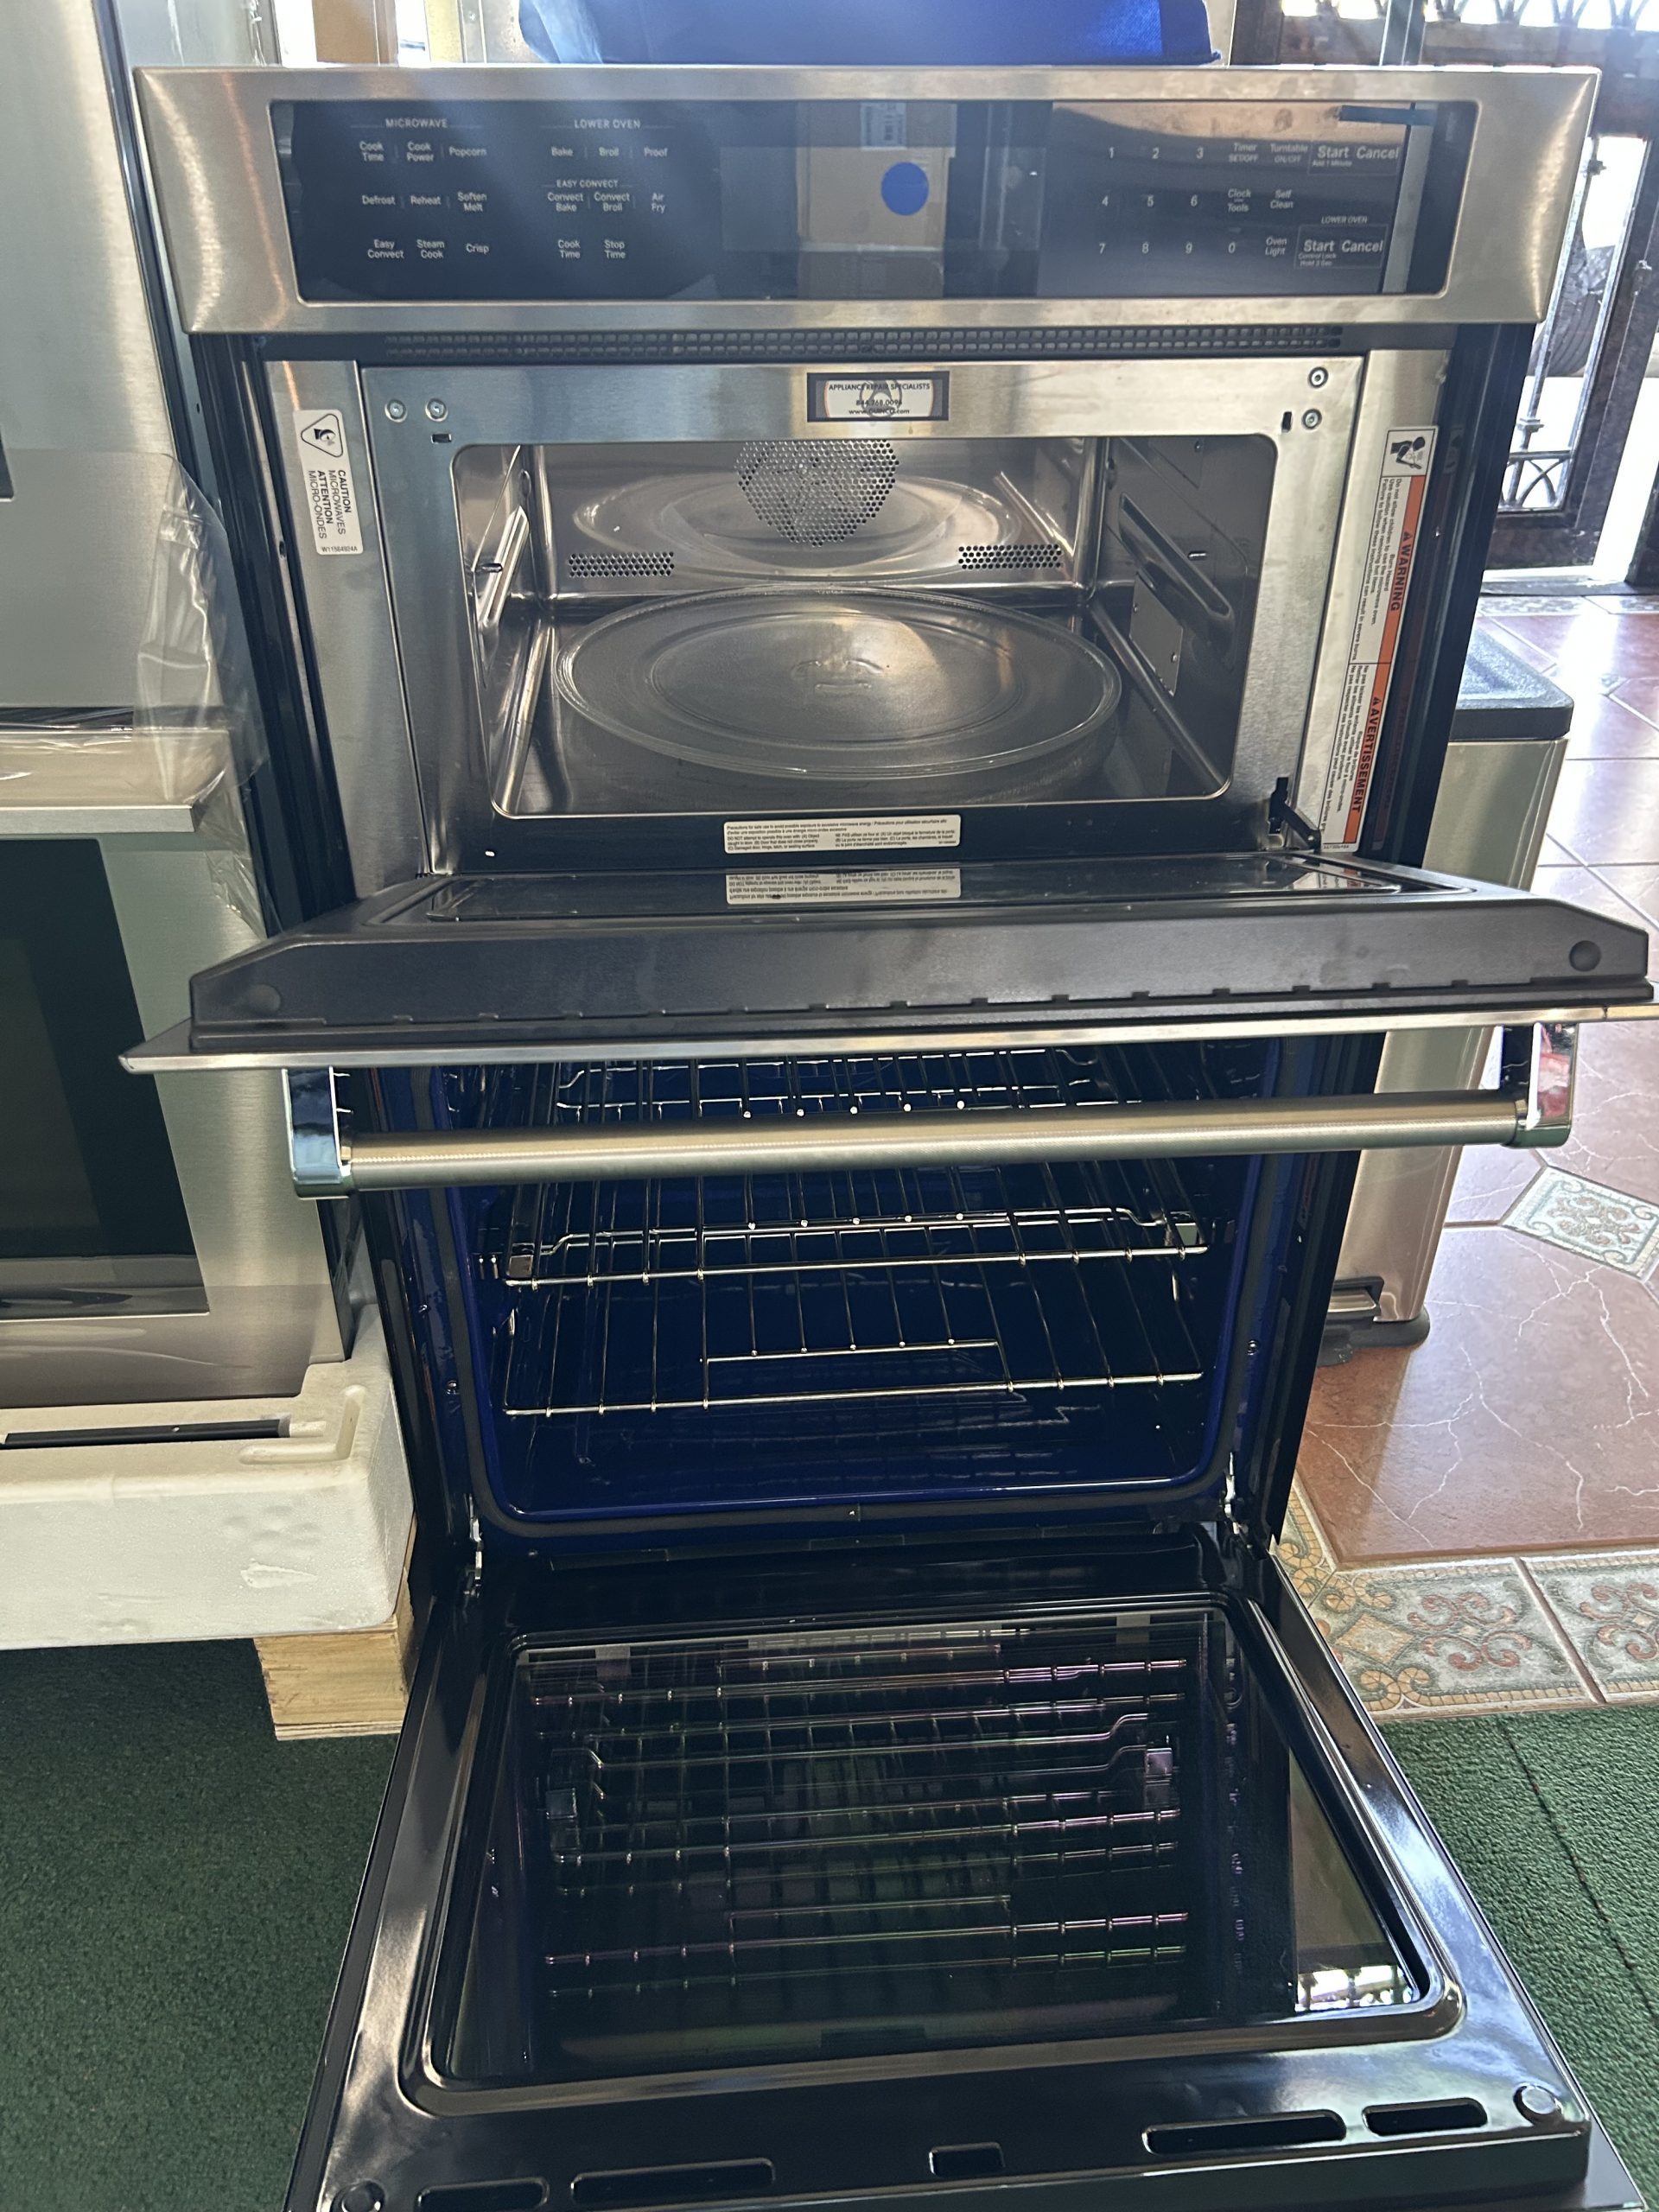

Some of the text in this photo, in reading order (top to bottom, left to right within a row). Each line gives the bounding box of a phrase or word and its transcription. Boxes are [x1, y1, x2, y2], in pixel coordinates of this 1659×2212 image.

[385, 118, 448, 129] MICROWAVE
[574, 119, 640, 129] LOWER OVEN
[359, 141, 384, 151] Cook
[407, 141, 431, 151] Cook
[448, 147, 486, 158] Popcorn
[550, 147, 574, 156] Bake
[599, 147, 620, 156] Broil
[644, 147, 668, 157] Proof
[1109, 147, 1115, 159] 1
[1152, 147, 1160, 159] 2
[1196, 147, 1204, 159] 3
[1318, 145, 1399, 160] Start Cancel
[362, 153, 385, 162] Time
[406, 153, 434, 162] Power
[556, 179, 619, 188] EASY CONVECT
[457, 190, 487, 201] Soften
[547, 192, 584, 202] Convect
[594, 192, 630, 202] Convect
[652, 193, 664, 201] Air
[1227, 188, 1251, 198] Clock
[1274, 189, 1293, 199] Self
[362, 194, 396, 206] Defrost
[410, 194, 442, 206] Reheat
[1102, 195, 1109, 207] 4
[1147, 194, 1154, 207] 5
[1190, 194, 1198, 207] 6
[1270, 200, 1294, 209] Clean
[463, 202, 483, 212] Melt
[556, 203, 577, 213] Bake
[603, 203, 623, 212] Broil
[651, 203, 665, 213] Fry
[1228, 203, 1249, 213] Tools
[373, 239, 395, 251] Easy
[416, 238, 445, 249] Steam
[557, 239, 581, 249] Cook
[604, 239, 625, 250] Stop
[1266, 237, 1287, 246] Oven
[1303, 239, 1382, 252] Start Cancel
[466, 243, 489, 255] Crisp
[1098, 242, 1106, 254] 7
[1141, 242, 1149, 254] 8
[1185, 242, 1193, 254] 9
[1265, 247, 1286, 257] Light
[367, 249, 404, 259] Convect
[421, 250, 444, 259] Cook
[560, 250, 581, 259] Time
[606, 250, 626, 259] Time
[338, 469, 352, 513] CAUTION
[317, 470, 334, 524] ATTENTION
[328, 469, 346, 535] MICROWAVES
[308, 470, 327, 539] MICRO-ONDES
[1389, 544, 1411, 610] WARNING
[1351, 708, 1380, 812] AVERTISSEMENT
